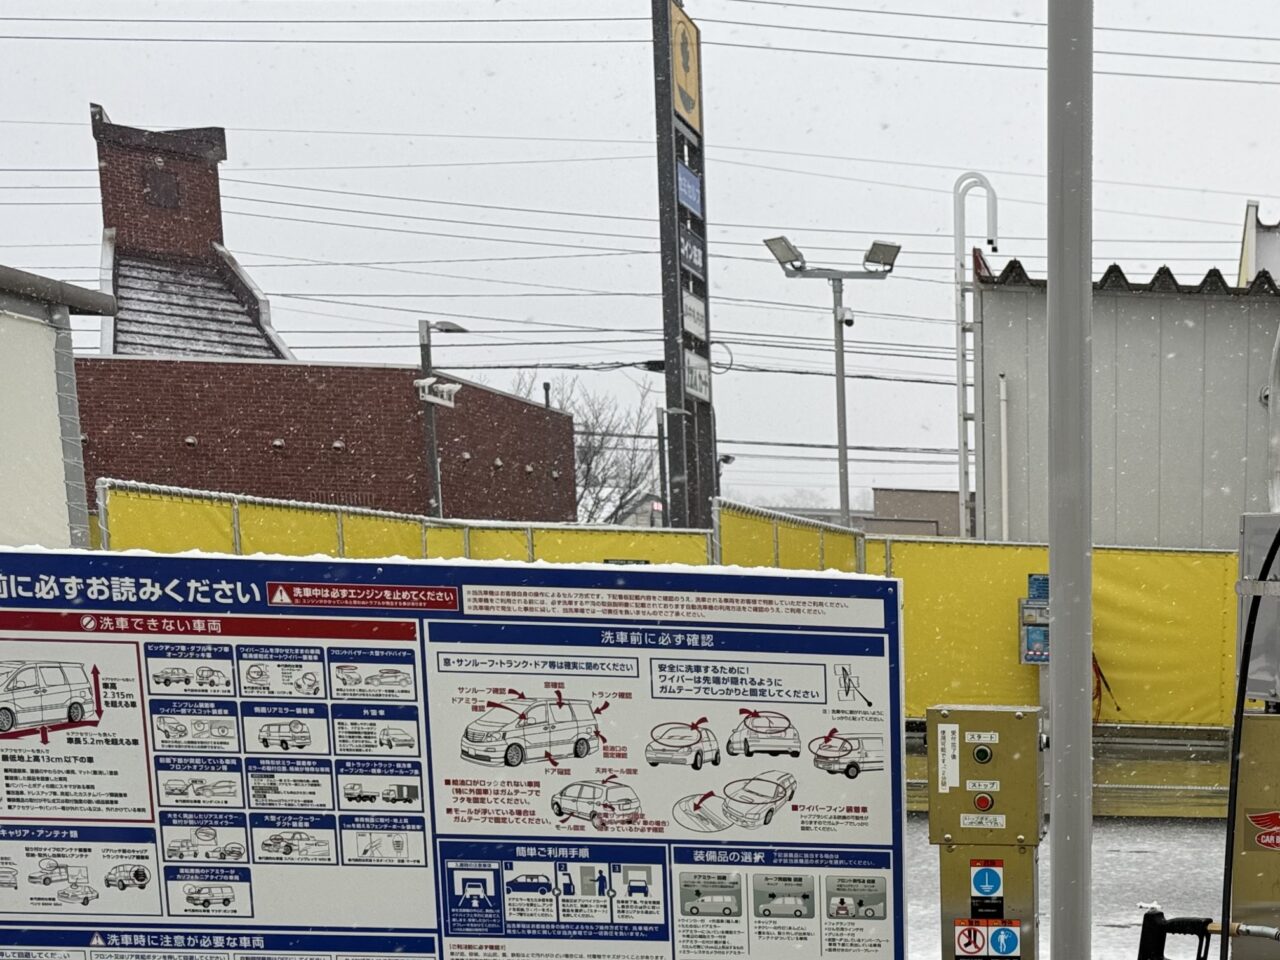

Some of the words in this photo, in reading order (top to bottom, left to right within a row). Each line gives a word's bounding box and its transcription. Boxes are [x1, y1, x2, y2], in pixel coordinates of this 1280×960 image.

[293, 587, 454, 601] 洗車中は必ずエンジンを止めてください
[100, 616, 222, 633] 洗車できない車両
[601, 630, 714, 647] 洗車前に必ず確認
[658, 675, 782, 686] ワイパーは先端が隠れるように
[103, 691, 134, 699] 2.315m
[457, 686, 507, 695] サンルーフ確認
[591, 691, 633, 699] トランク確認
[659, 685, 819, 699] ガムテープでしっかりと固定してください
[104, 700, 137, 708] を超える車
[67, 737, 139, 746] 車長5.2mを超える車
[2, 754, 94, 764] 最低地上高13cm以下の車
[799, 805, 868, 813] ワイパーフィン装着車
[1261, 835, 1275, 843] CAR
[516, 847, 590, 859] 簡単ご利用手順
[693, 850, 765, 862] 装備品の選択
[107, 934, 264, 949] 洗車時に注意が必要な車両
